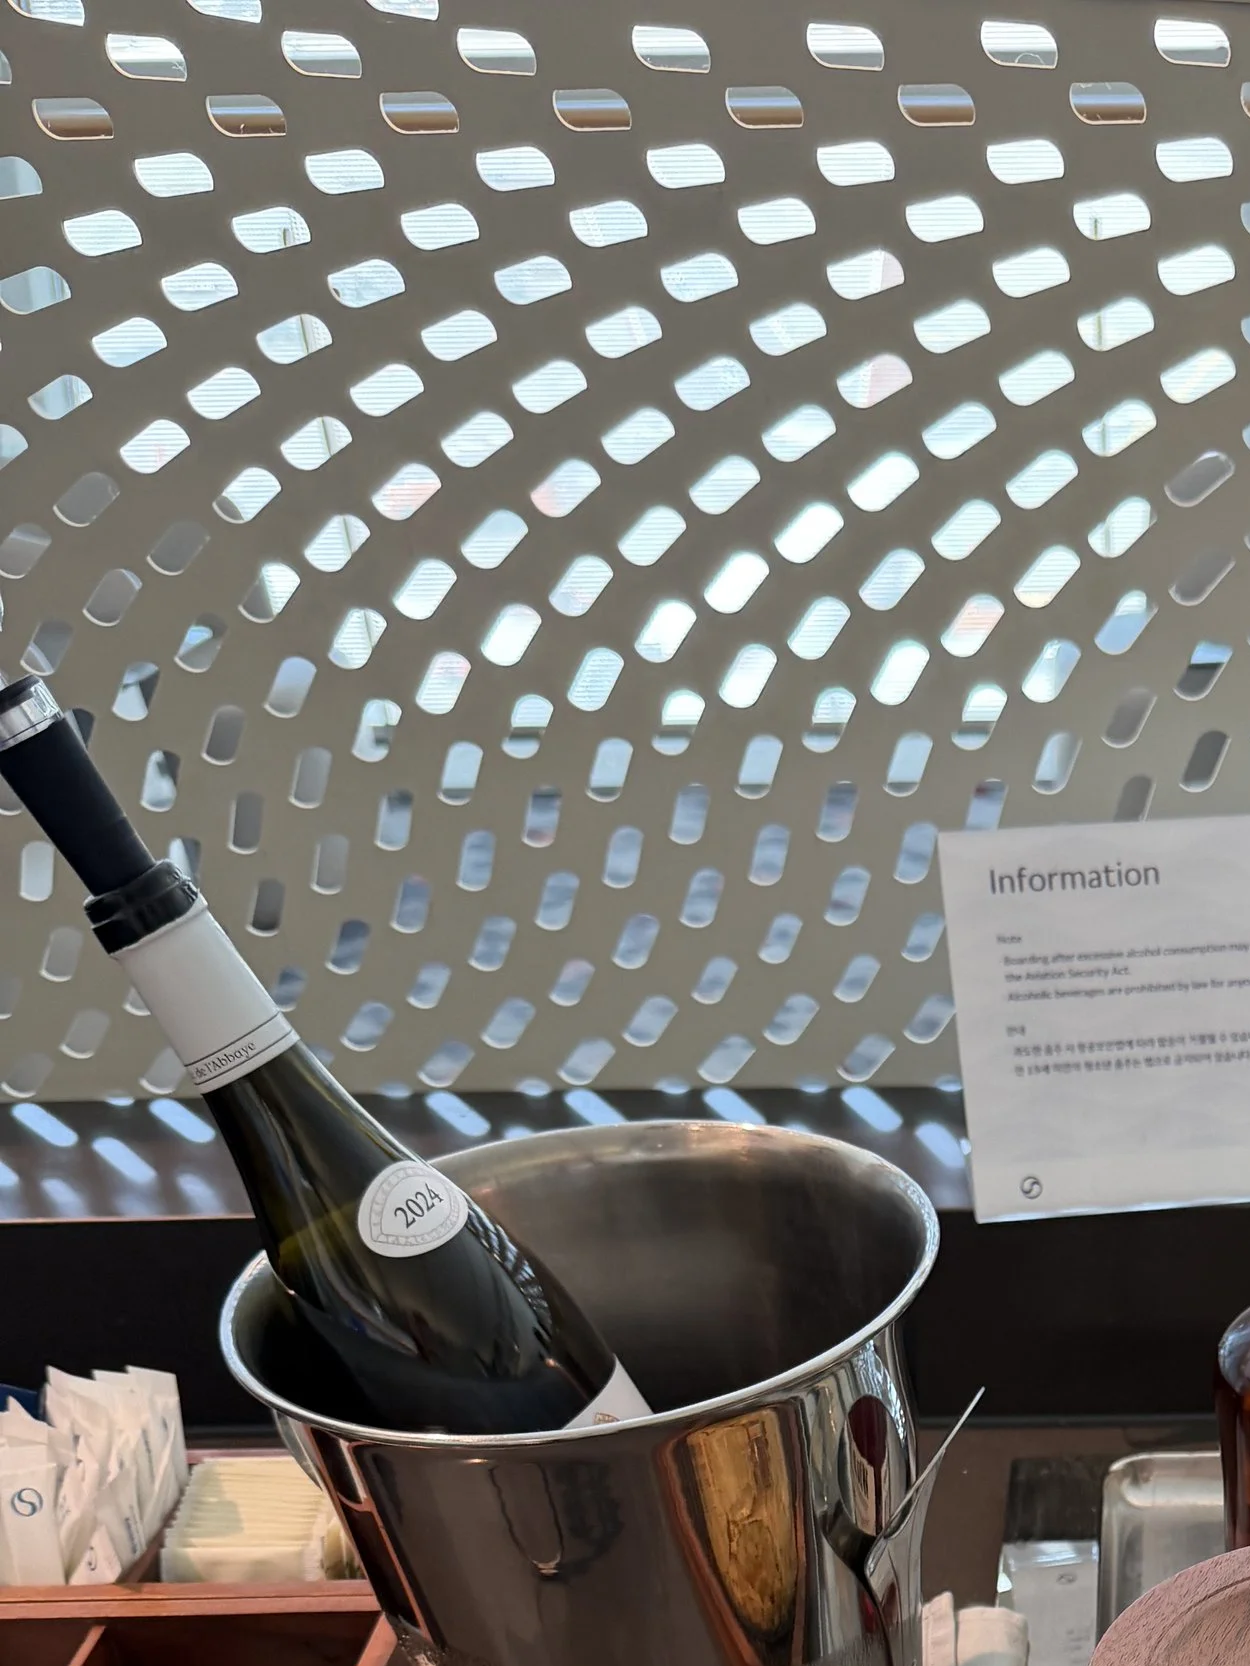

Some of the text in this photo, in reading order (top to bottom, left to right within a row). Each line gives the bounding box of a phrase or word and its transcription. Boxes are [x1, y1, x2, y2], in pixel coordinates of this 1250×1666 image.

[989, 861, 1161, 896] Information
[205, 1042, 257, 1073] l'Abbaye
[394, 1182, 444, 1229] 2024
